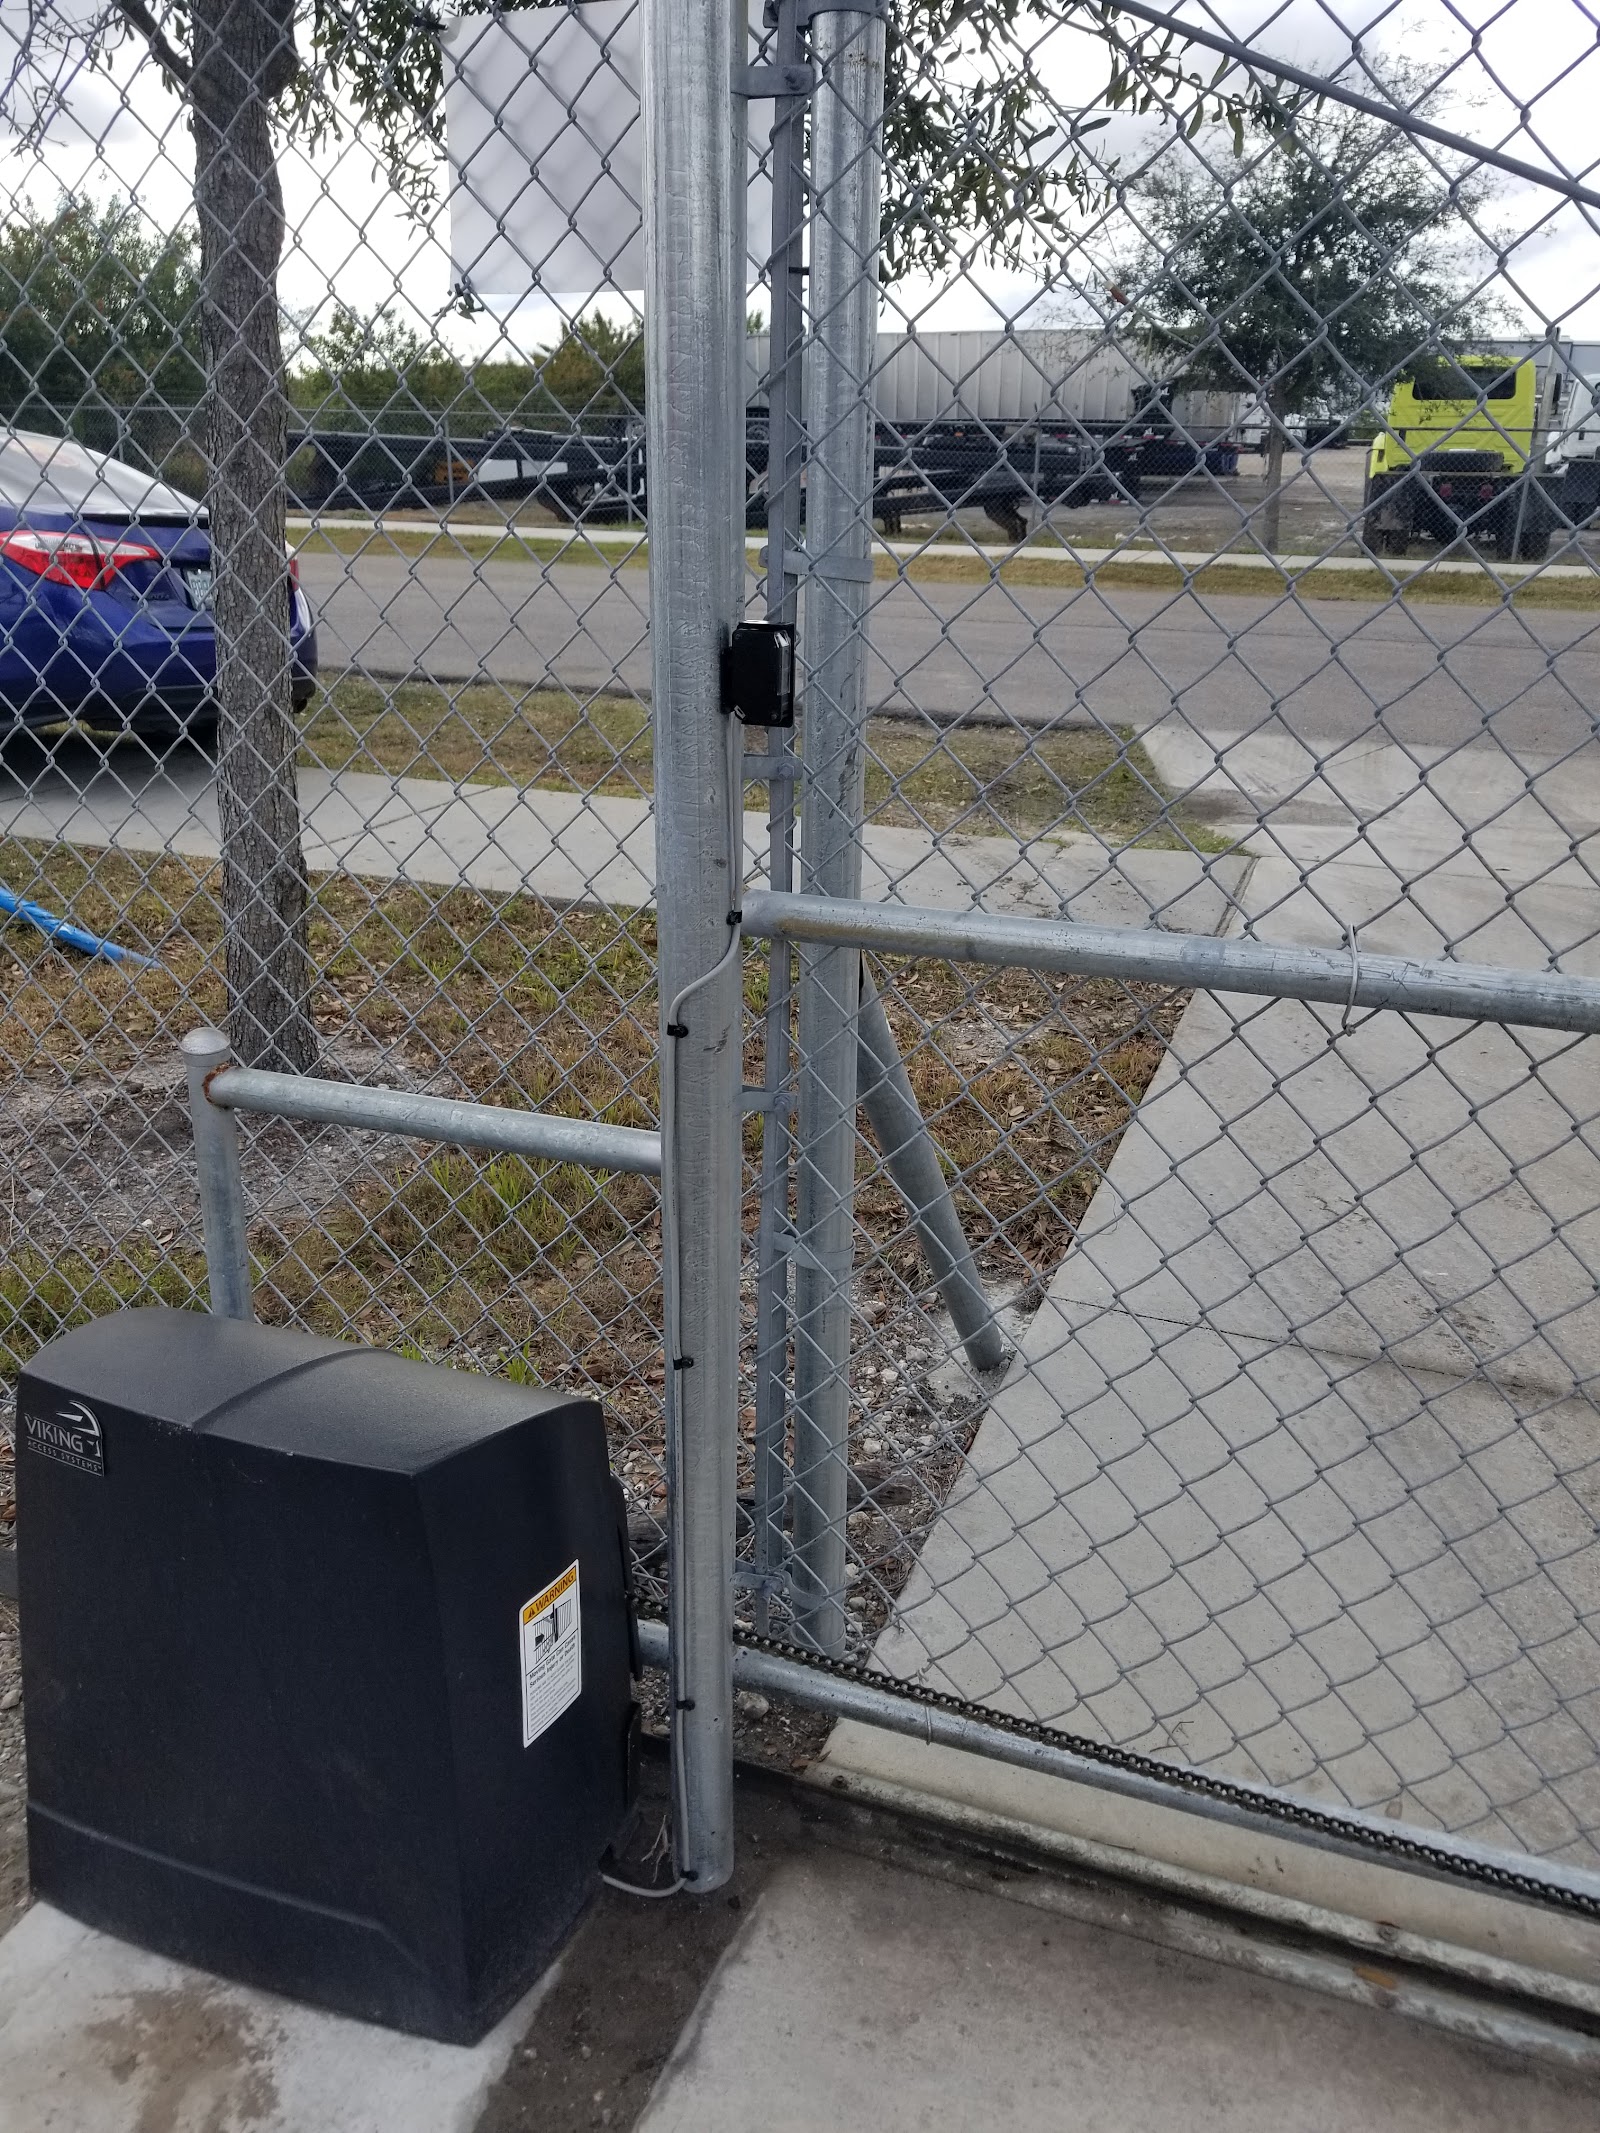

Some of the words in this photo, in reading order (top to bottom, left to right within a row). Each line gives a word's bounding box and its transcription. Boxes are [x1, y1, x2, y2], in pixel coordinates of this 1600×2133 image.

[24, 1415, 84, 1454] VIKING
[27, 1440, 57, 1457] ACCESS
[535, 1571, 575, 1612] WARNING
